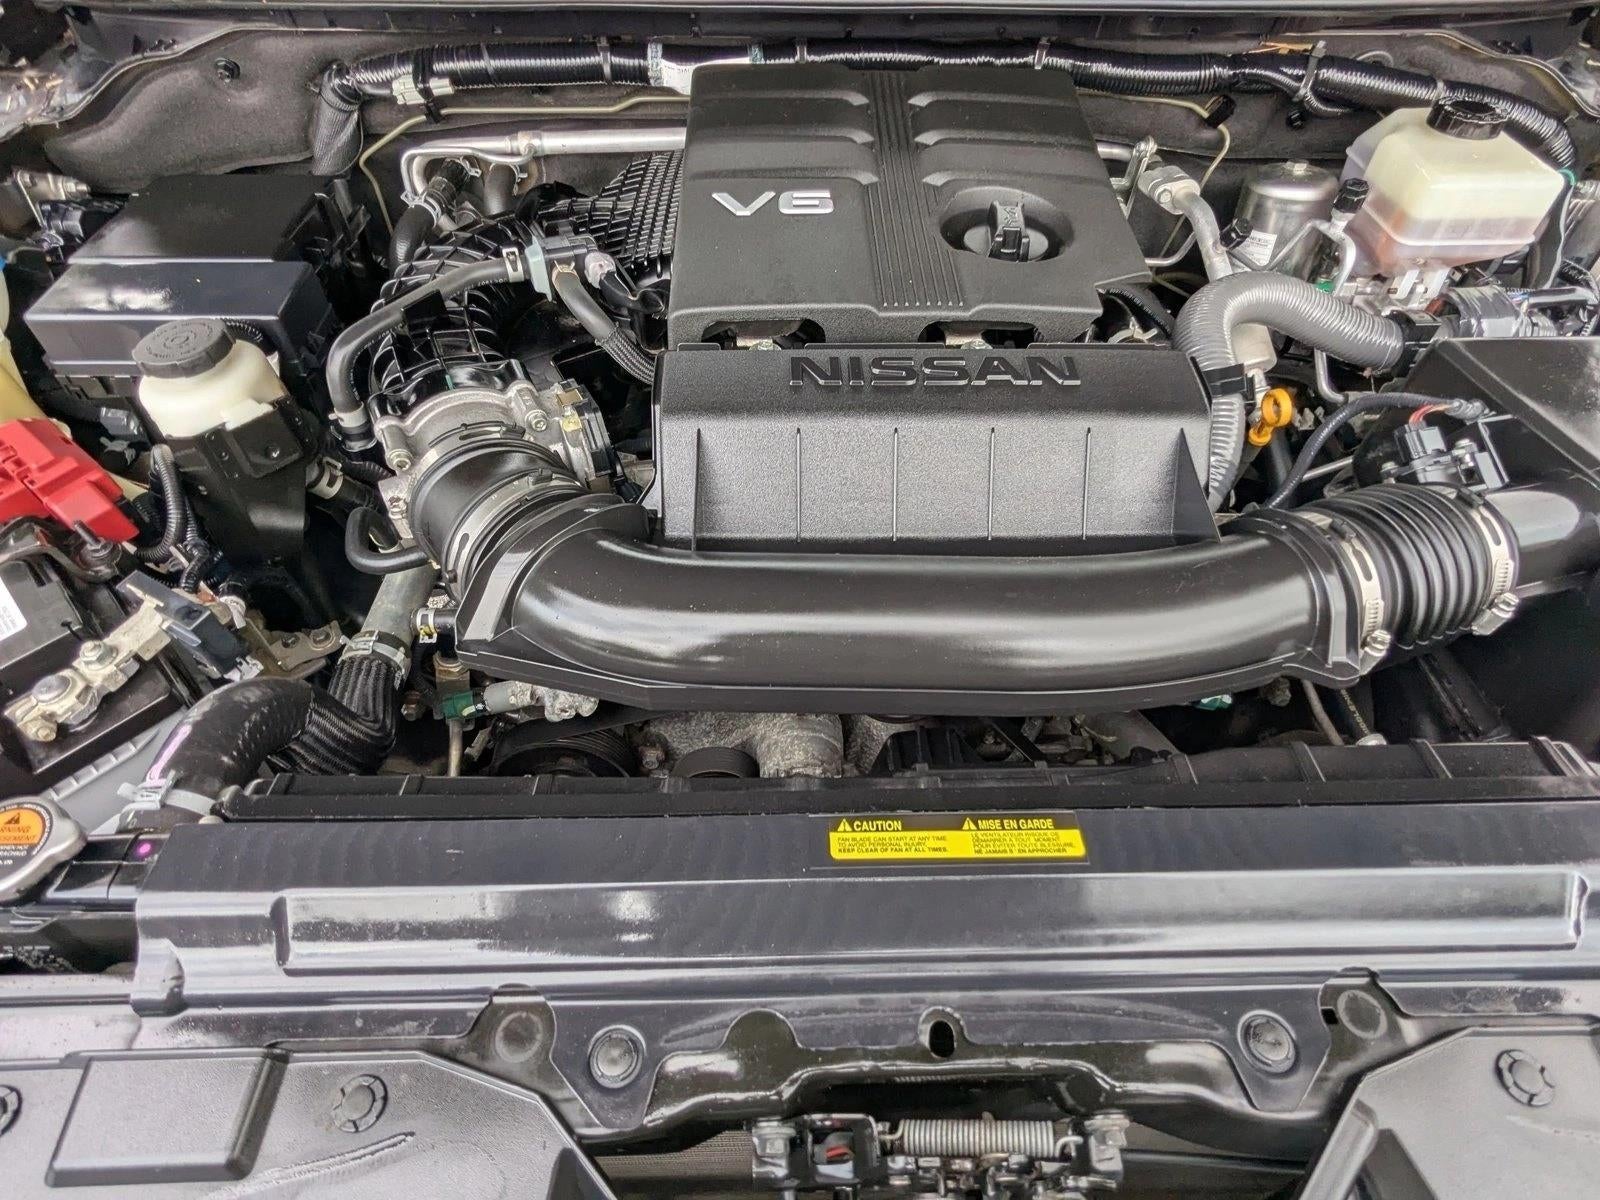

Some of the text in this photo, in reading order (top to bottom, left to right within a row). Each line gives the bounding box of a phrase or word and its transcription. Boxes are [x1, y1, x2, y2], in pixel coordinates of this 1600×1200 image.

[711, 190, 834, 216] V6
[789, 356, 1081, 387] NISSAN
[853, 820, 902, 831] CAUTION
[977, 818, 1055, 830] MISE EN GARDE
